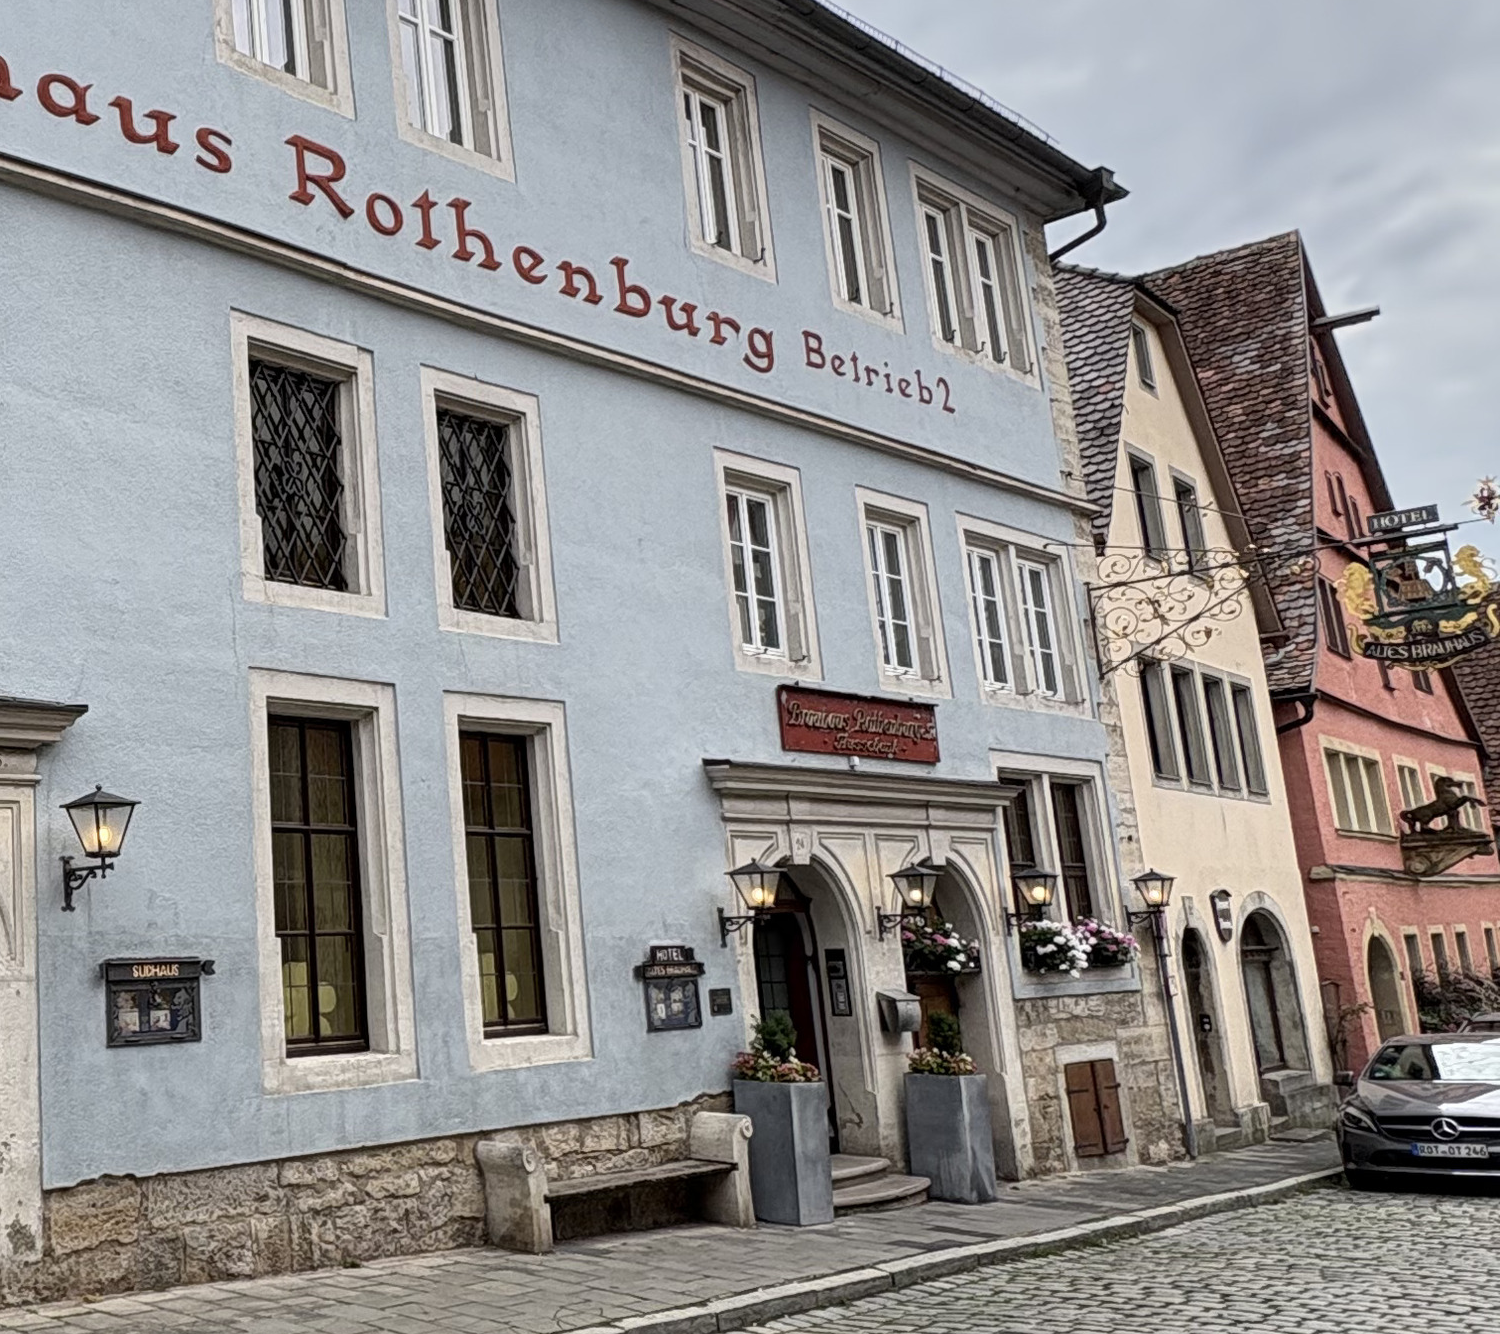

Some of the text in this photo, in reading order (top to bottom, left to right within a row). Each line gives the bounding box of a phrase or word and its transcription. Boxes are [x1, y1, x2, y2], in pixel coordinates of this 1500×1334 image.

[283, 133, 774, 373] Rothenburg
[1372, 509, 1429, 530] HOTEL
[1411, 628, 1485, 659] BRAUHAUS
[656, 947, 684, 962] HOTEL
